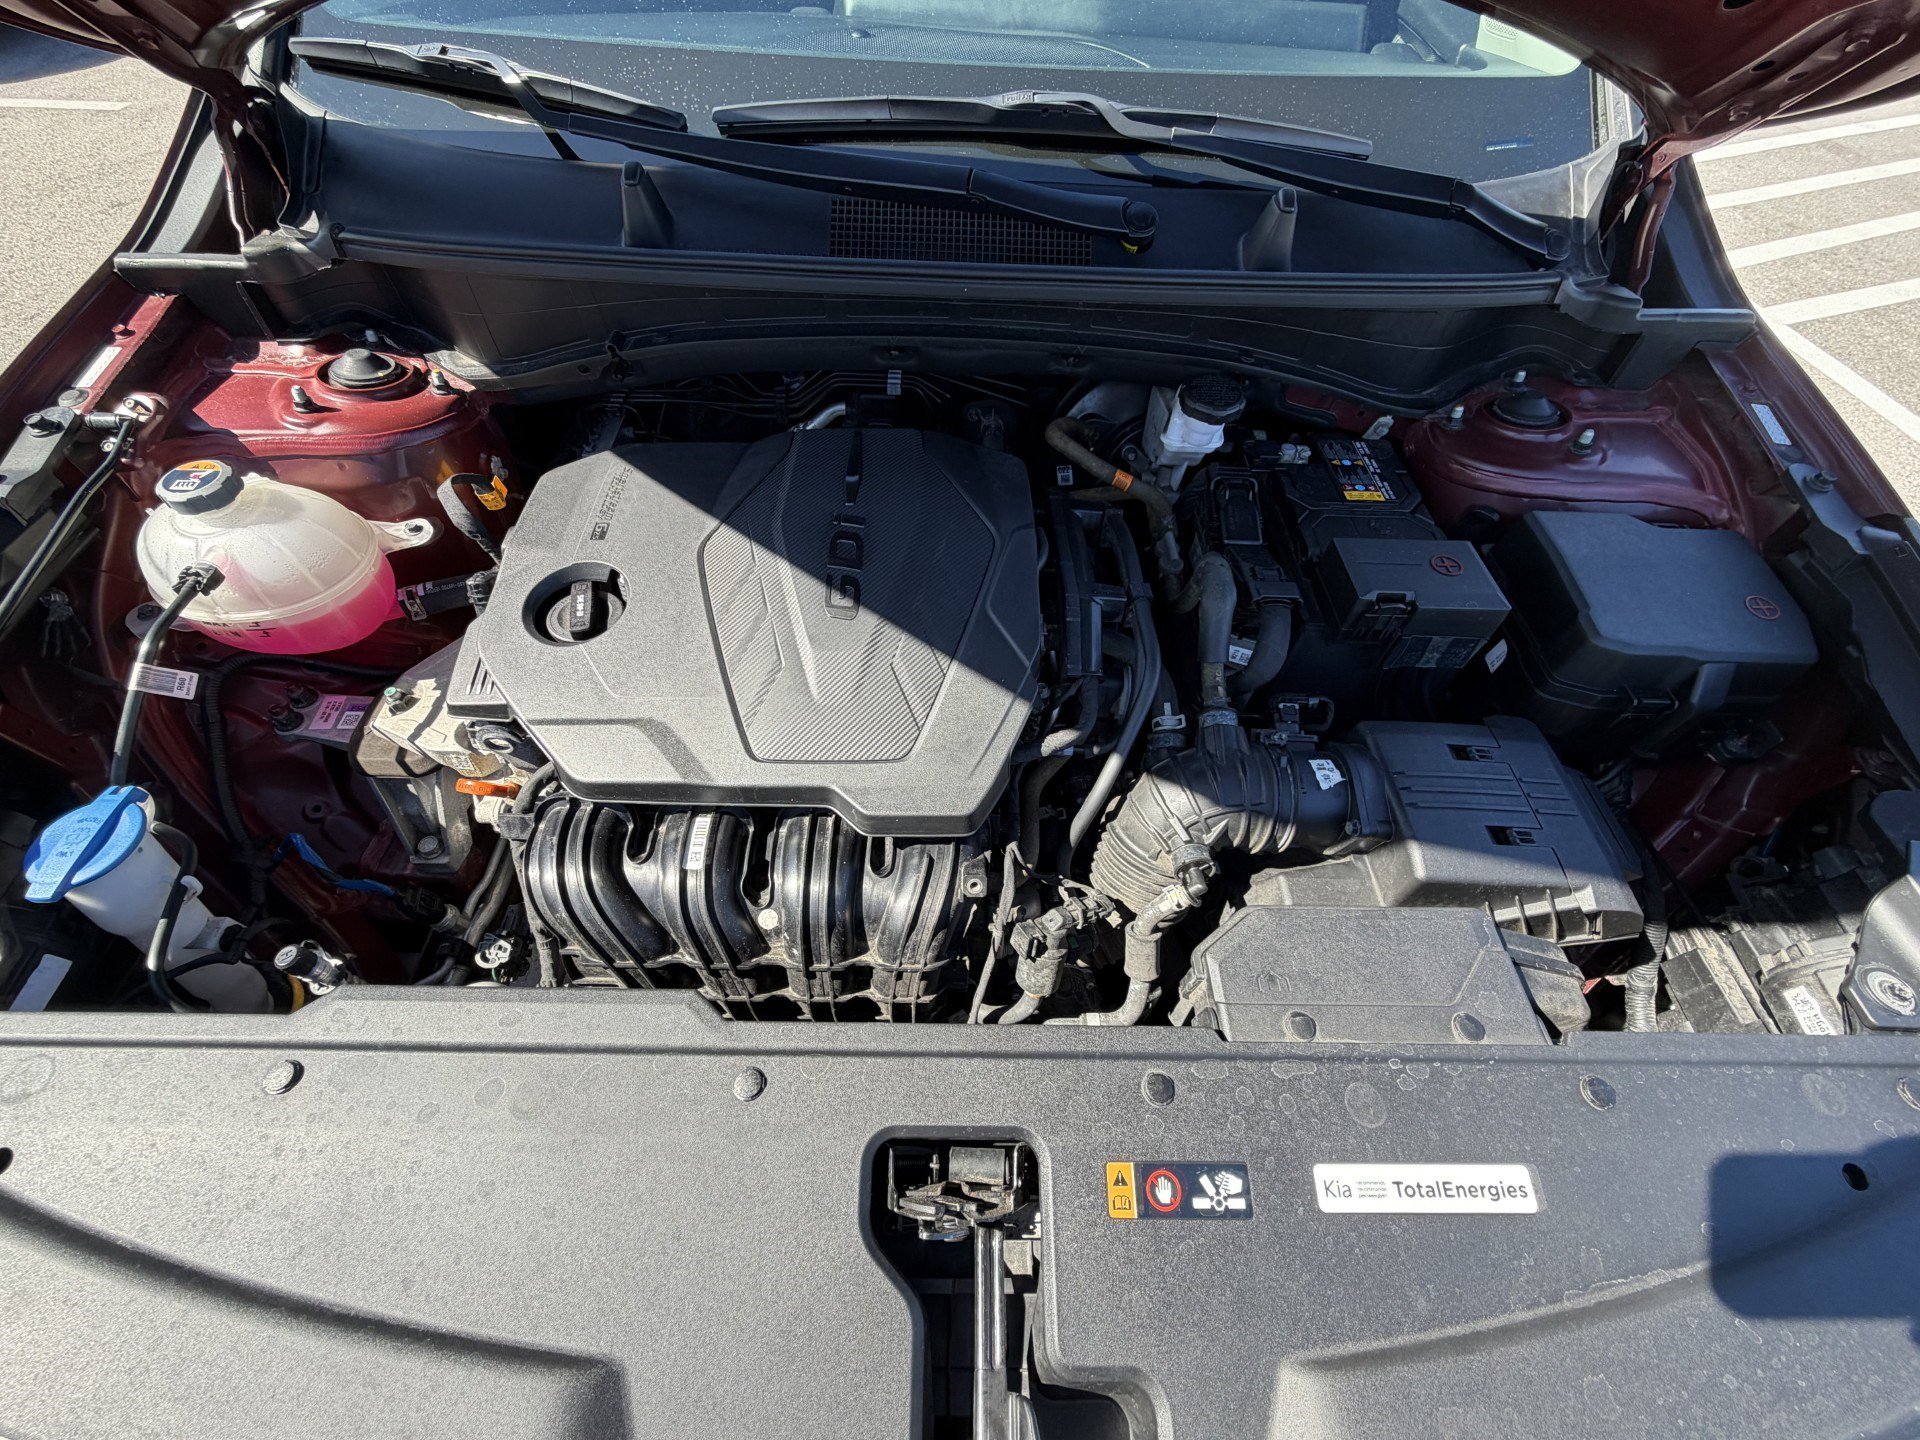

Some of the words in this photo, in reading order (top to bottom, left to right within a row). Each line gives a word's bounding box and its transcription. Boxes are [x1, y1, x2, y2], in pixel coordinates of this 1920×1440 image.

[176, 677, 186, 691] R60
[1323, 1179, 1352, 1198] Kia
[1391, 1180, 1529, 1202] TotalEnergies
